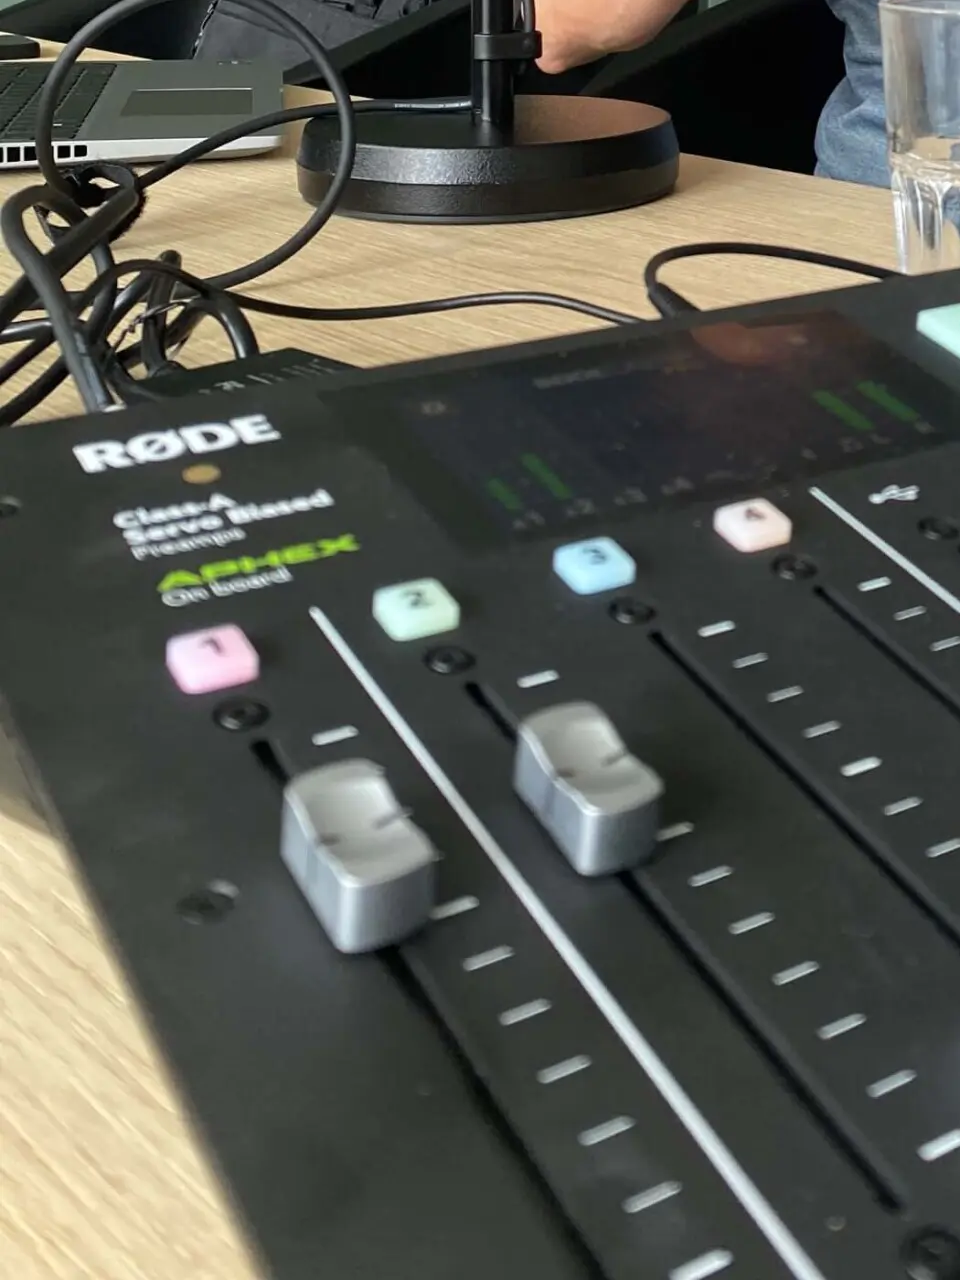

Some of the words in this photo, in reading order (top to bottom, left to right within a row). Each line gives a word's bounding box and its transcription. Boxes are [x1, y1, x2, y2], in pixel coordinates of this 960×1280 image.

[72, 414, 282, 473] RØDE
[122, 514, 224, 546] Servo
[226, 488, 335, 525] Biased
[157, 534, 361, 592] APHEX
[161, 586, 210, 607] On
